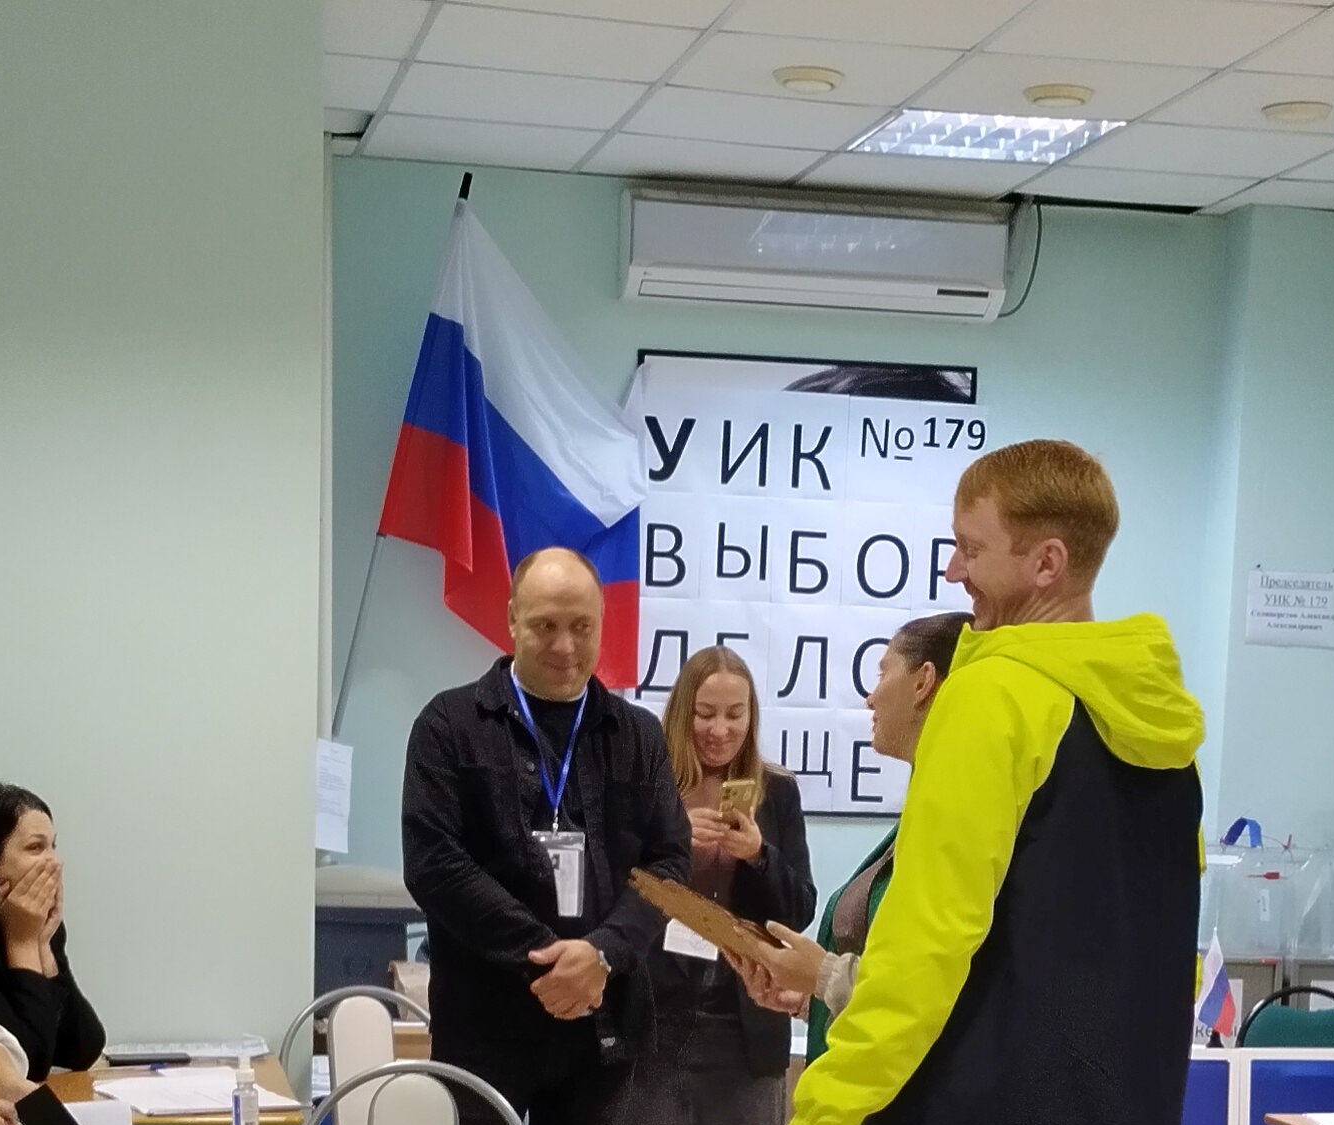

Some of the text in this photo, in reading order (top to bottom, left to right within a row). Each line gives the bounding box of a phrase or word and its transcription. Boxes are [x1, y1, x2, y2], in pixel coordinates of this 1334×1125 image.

[644, 415, 987, 490] УИК № 179
[1259, 575, 1333, 590] Председатель
[1265, 594, 1328, 608] УИК № 179
[635, 629, 890, 700] ДЛО
